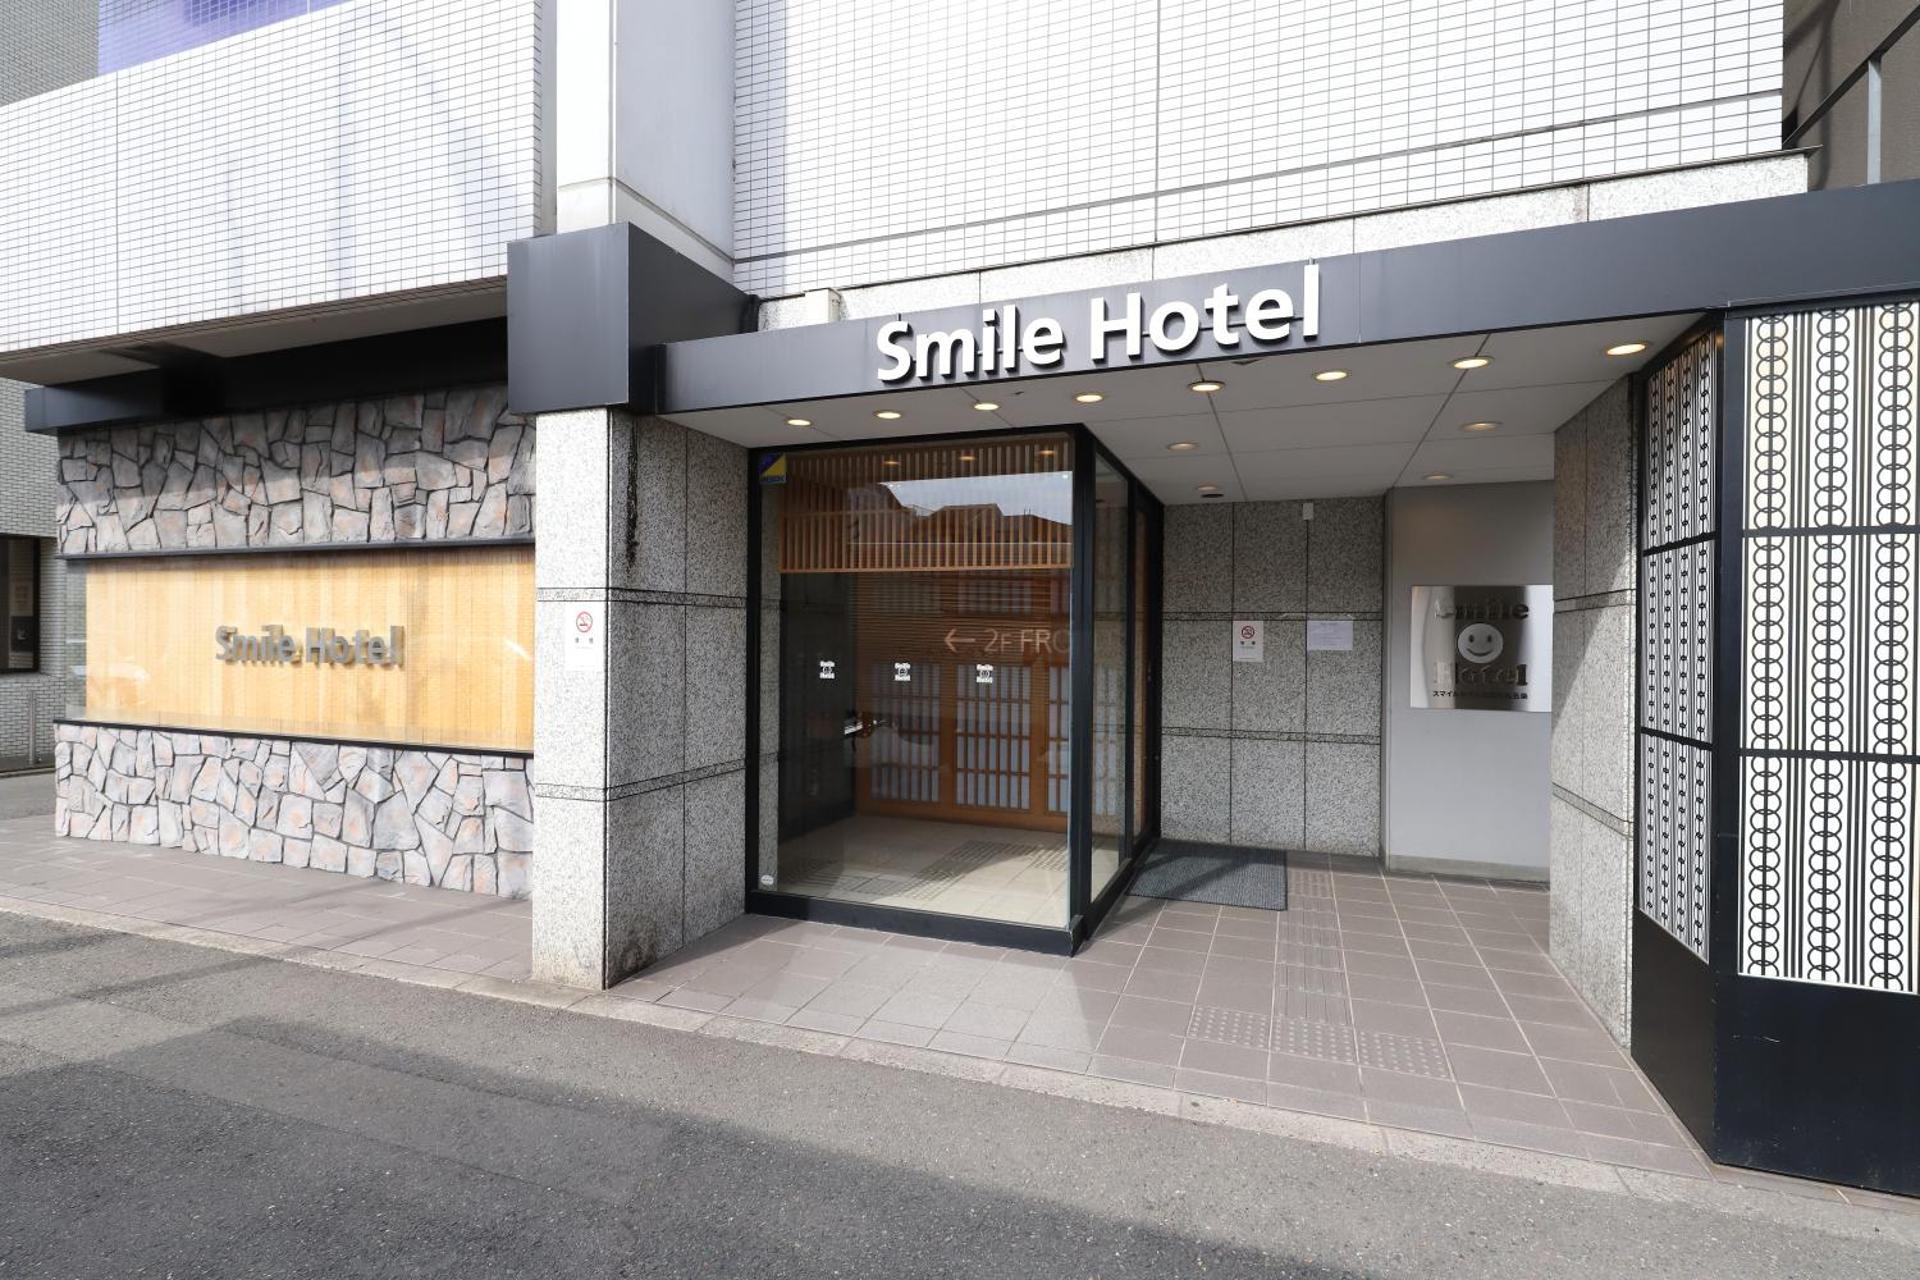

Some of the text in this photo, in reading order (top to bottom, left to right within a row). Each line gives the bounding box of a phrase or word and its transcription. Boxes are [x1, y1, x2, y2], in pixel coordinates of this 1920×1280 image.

[876, 261, 1321, 383] Smile Hotel
[215, 624, 405, 666] Smile Hotel
[983, 628, 1012, 653] 2F
